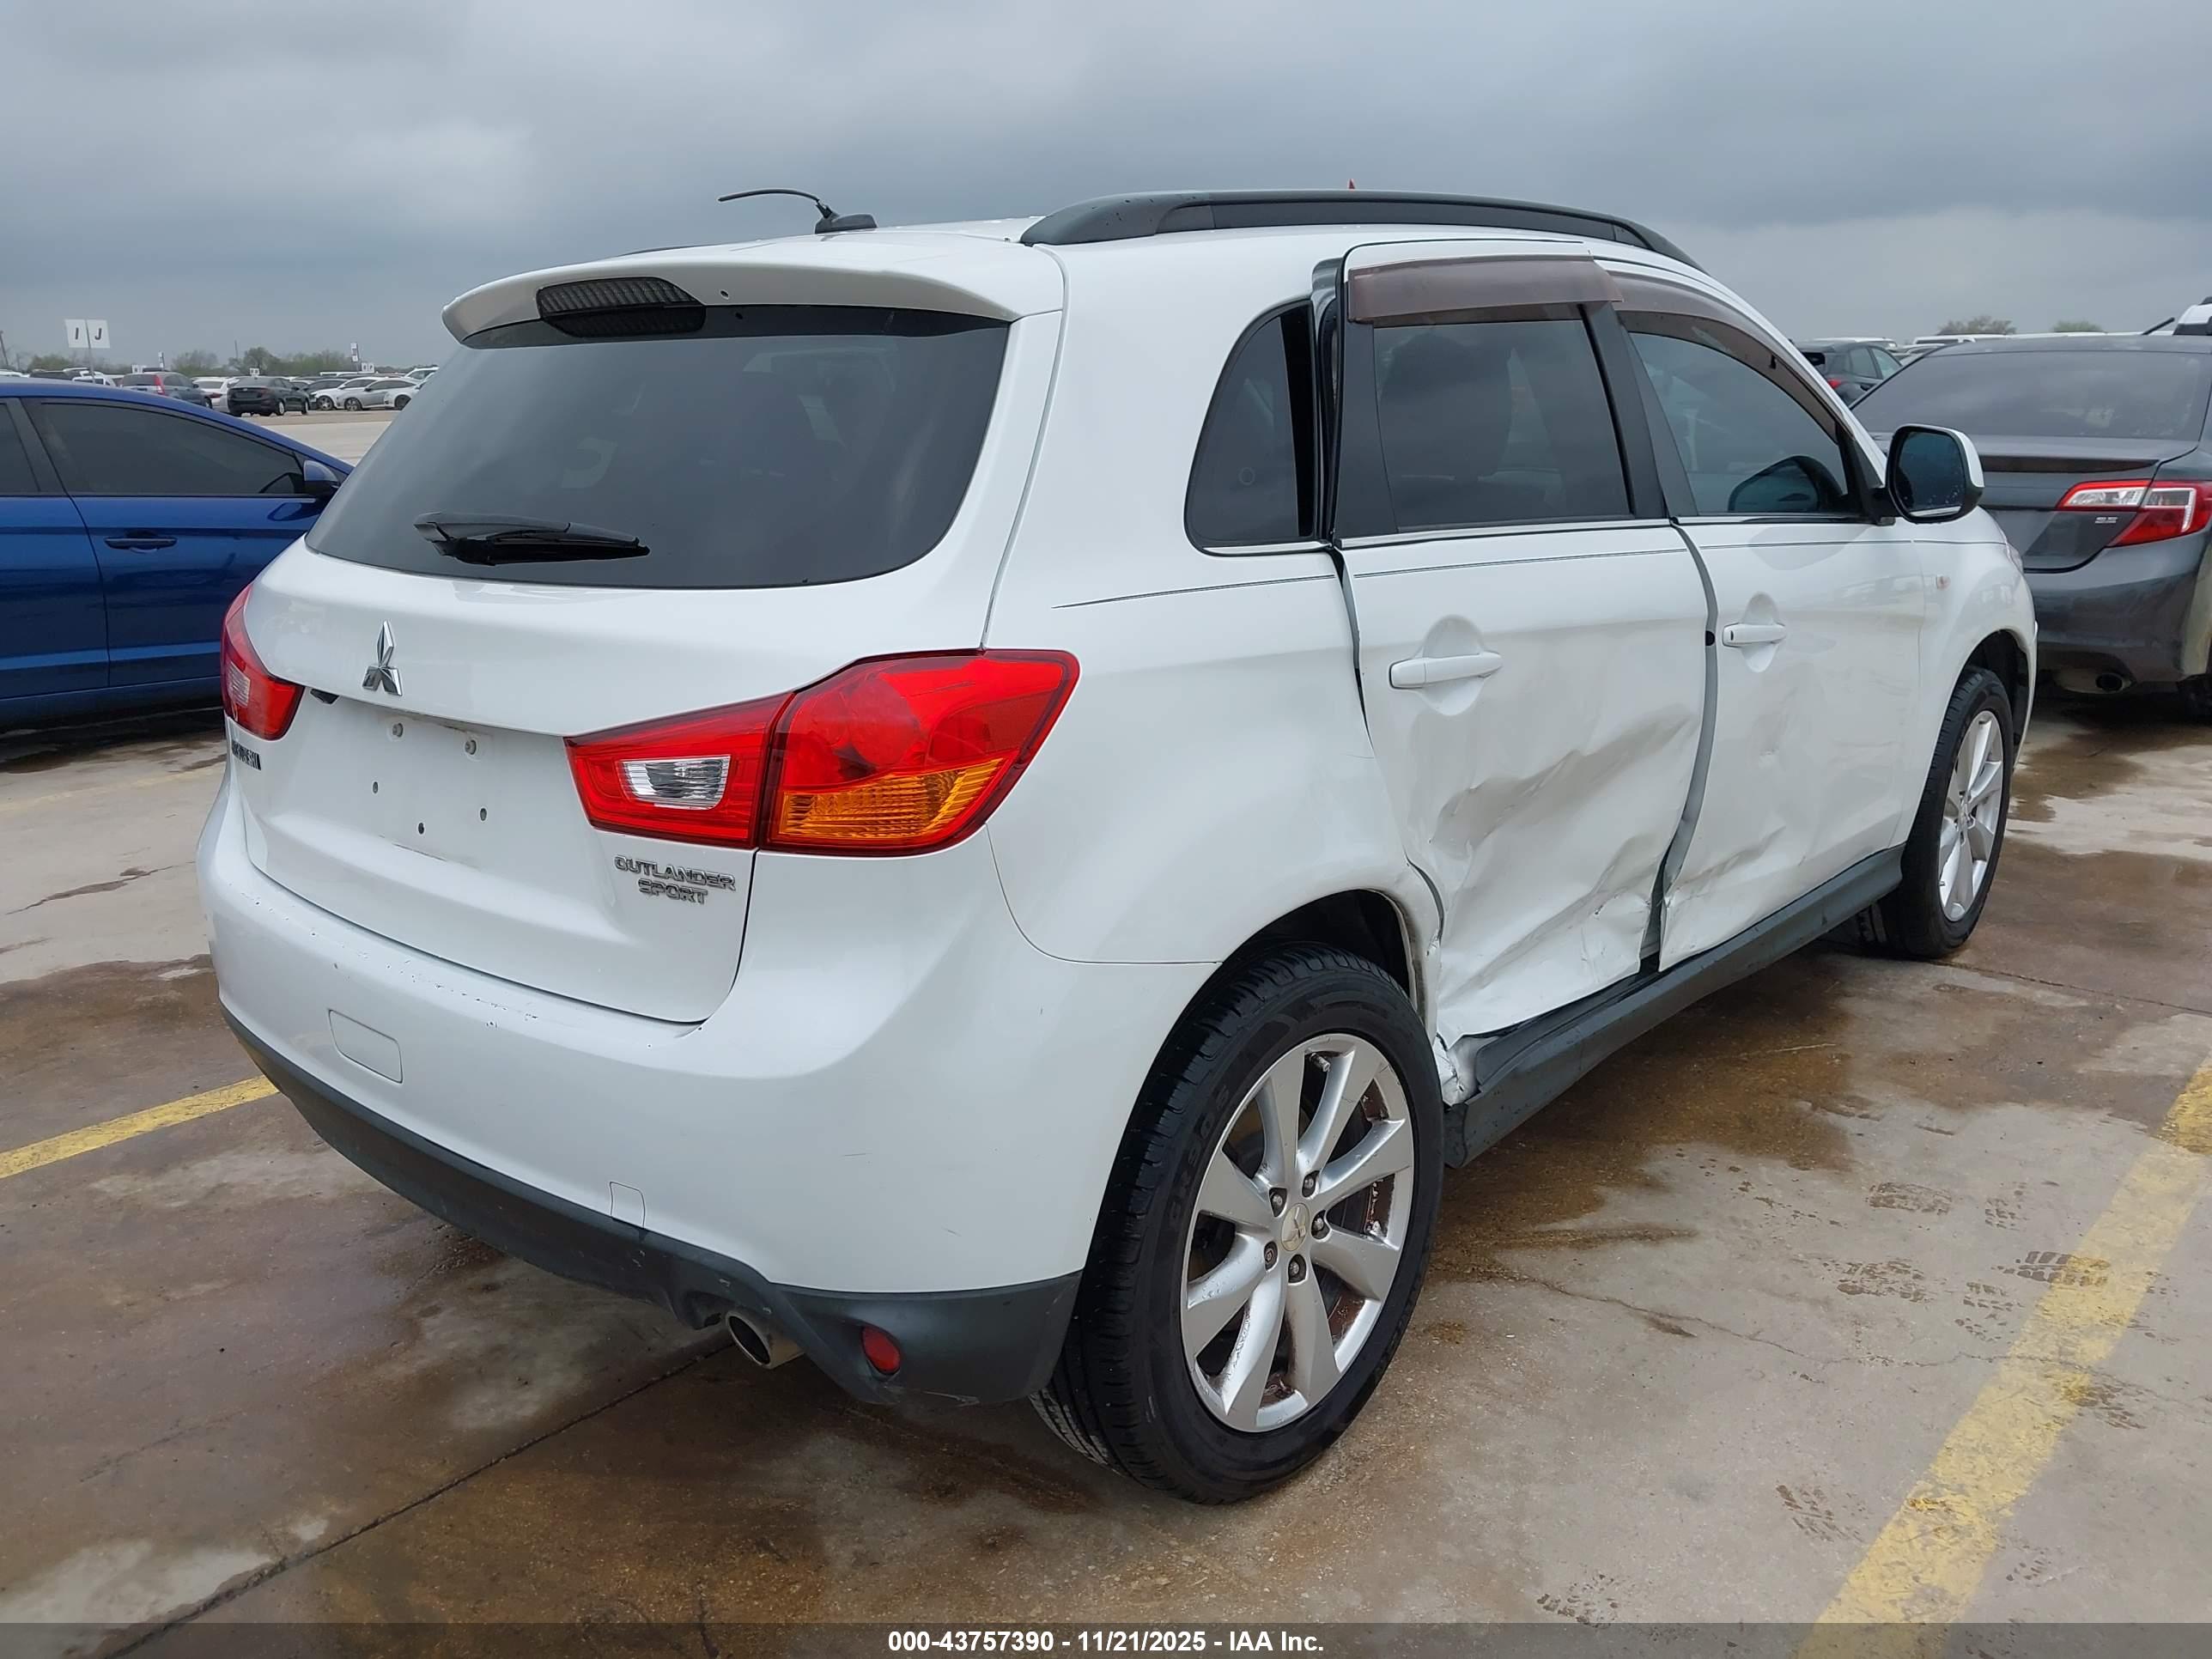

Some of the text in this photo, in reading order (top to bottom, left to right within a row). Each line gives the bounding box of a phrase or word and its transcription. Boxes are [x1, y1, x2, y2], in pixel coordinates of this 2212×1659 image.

[94, 328, 102, 340] J
[613, 854, 736, 891] OUTLANDER
[638, 878, 708, 904] SPORT
